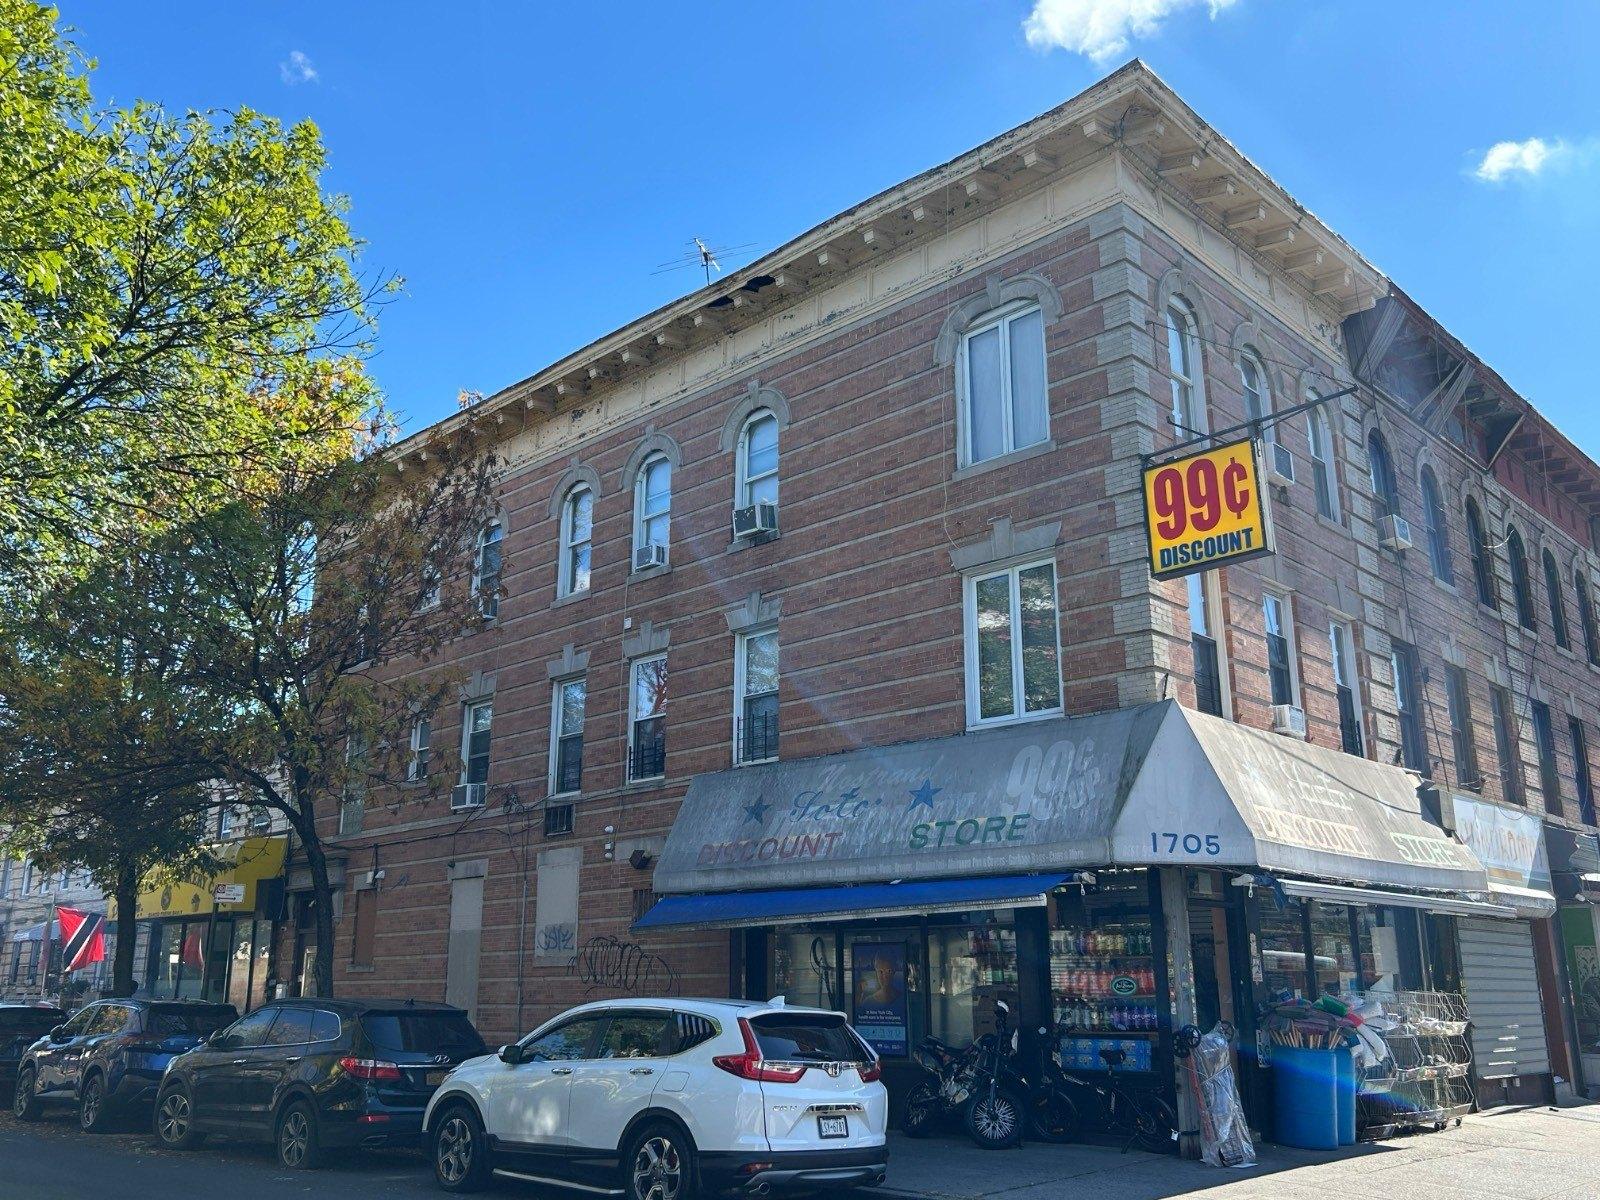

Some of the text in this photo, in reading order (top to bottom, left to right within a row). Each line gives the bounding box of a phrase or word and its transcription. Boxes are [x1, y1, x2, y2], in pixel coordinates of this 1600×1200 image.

[1153, 456, 1250, 541] 99¢
[1159, 527, 1253, 569] DISCOUNT
[909, 813, 1031, 850] STORE
[1150, 832, 1221, 856] 1705
